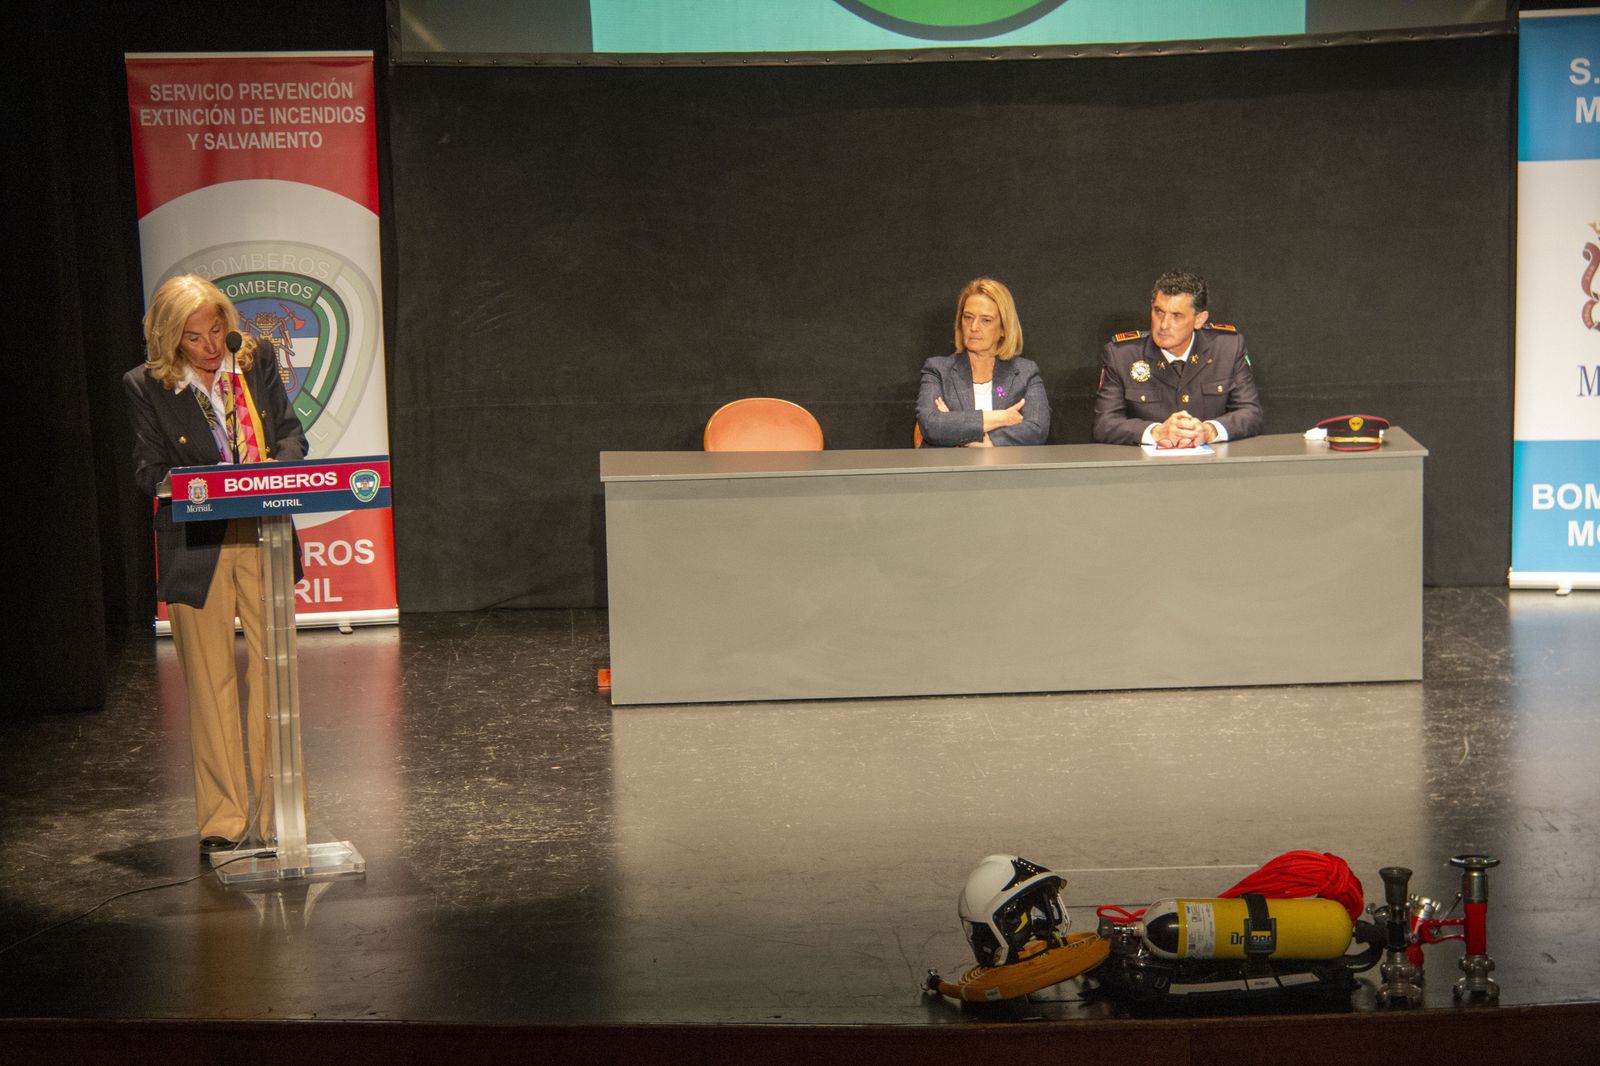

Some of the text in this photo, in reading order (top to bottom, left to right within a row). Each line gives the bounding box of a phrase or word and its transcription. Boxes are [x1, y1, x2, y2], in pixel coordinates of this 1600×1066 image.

[150, 77, 353, 101] SERVICIO PREVENCIÓN
[140, 104, 366, 126] EXTINCIÓN DE INCENDIOS
[187, 131, 323, 150] Y SALVAMENTO
[224, 472, 337, 492] BOMBEROS
[262, 498, 302, 509] MOTRIL
[1568, 520, 1600, 547] M
